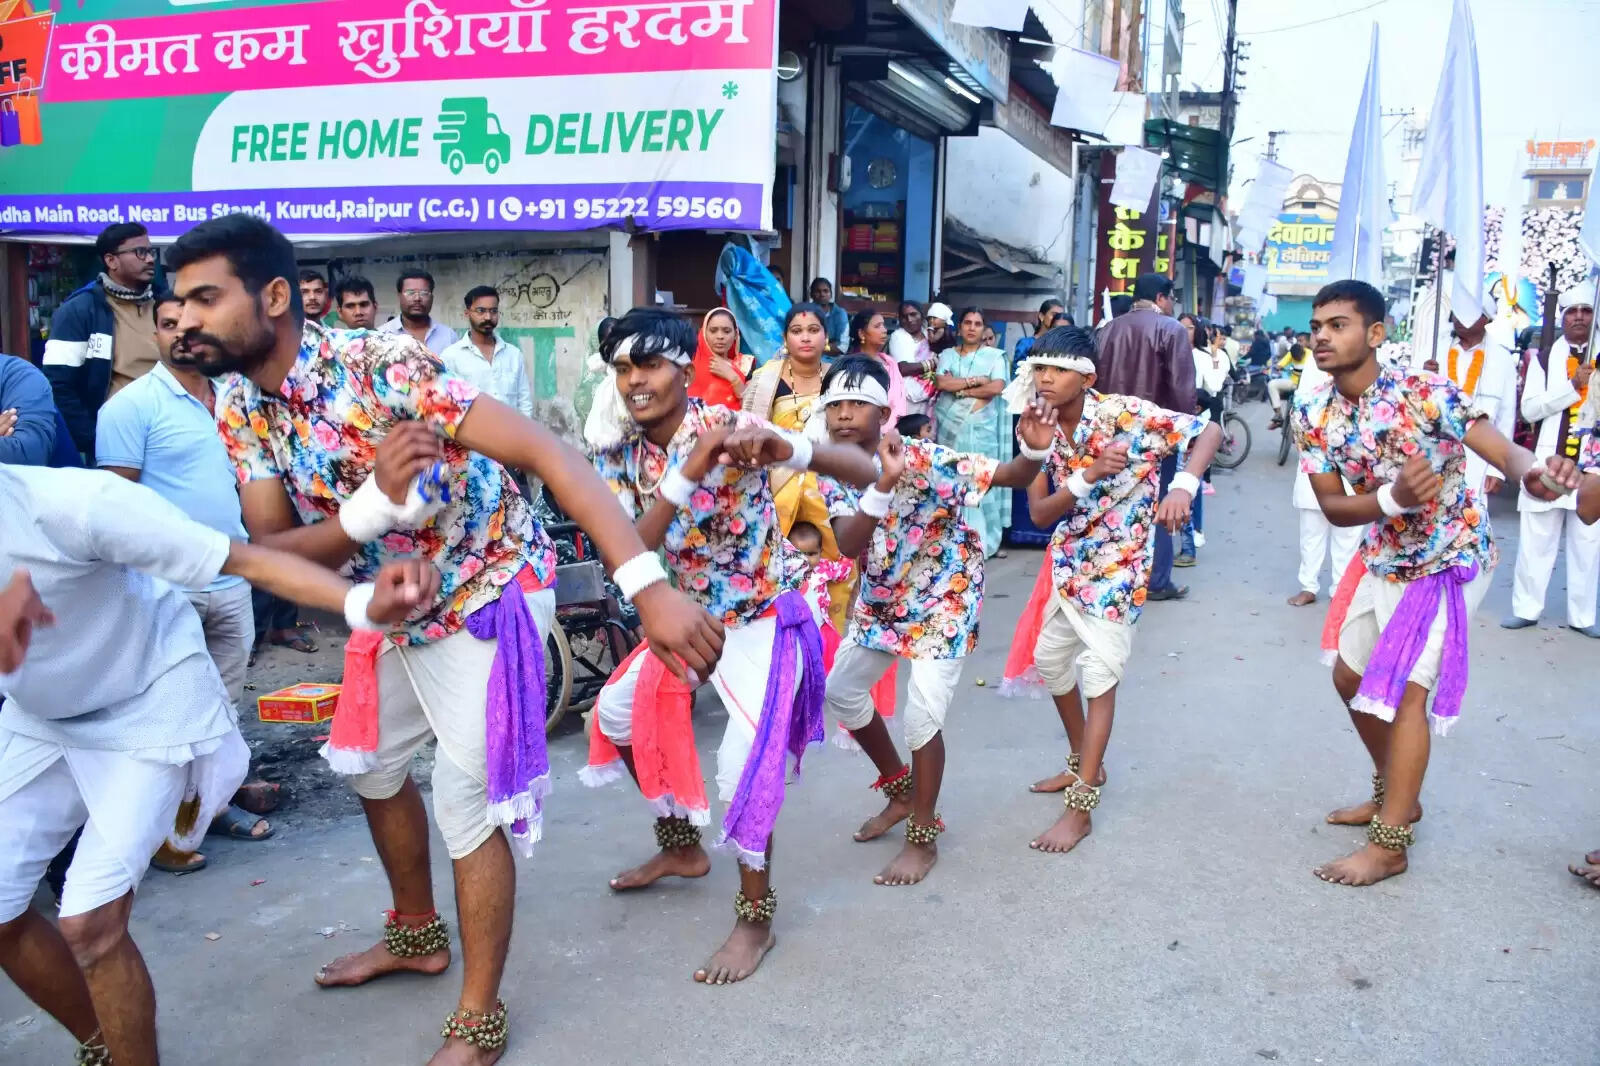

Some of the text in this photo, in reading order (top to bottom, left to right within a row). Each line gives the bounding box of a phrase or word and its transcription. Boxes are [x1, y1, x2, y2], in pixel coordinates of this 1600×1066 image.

[59, 24, 201, 80] कीमत
[213, 25, 310, 69] कम
[566, 0, 755, 54] हरदम
[231, 108, 725, 163] FREE HOME DELIVERY
[0, 206, 31, 223] dha
[35, 204, 73, 222] Main
[77, 204, 124, 224] Road,
[128, 204, 170, 222] Near
[174, 204, 207, 222] Bus
[418, 198, 480, 222] (C.G.)
[525, 198, 566, 220] +91
[573, 197, 648, 220] 95222
[656, 196, 742, 220] 59560
